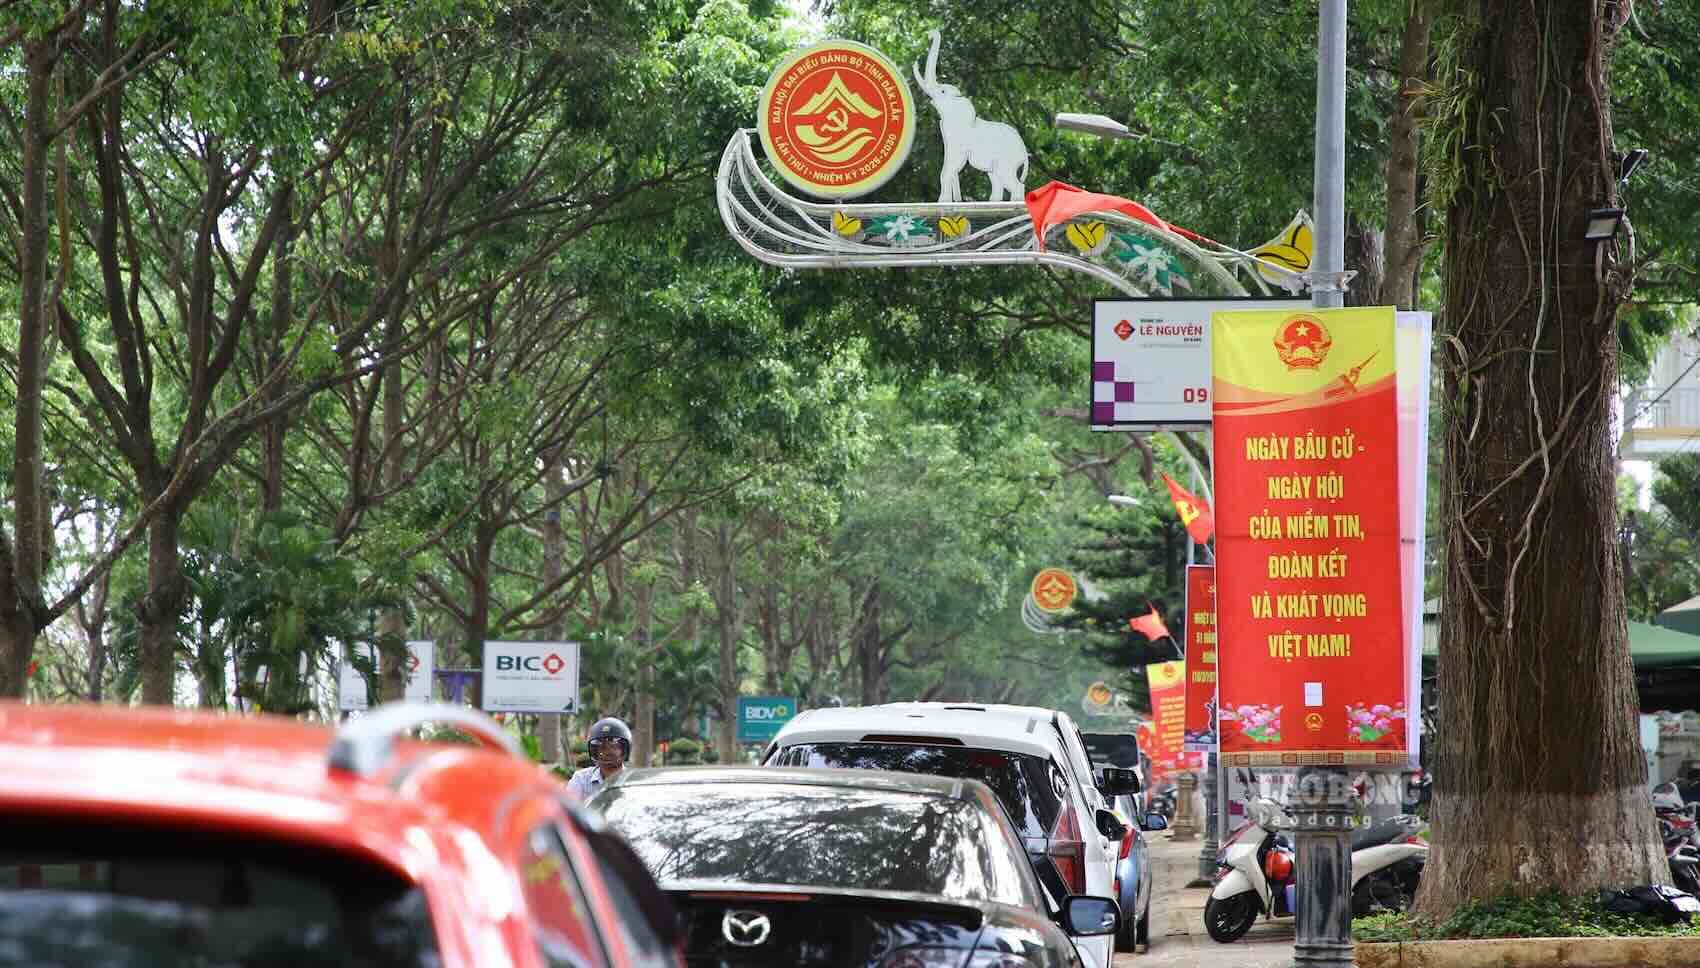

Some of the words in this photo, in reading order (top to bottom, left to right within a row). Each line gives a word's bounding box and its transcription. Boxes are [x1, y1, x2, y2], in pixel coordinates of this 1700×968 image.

[776, 88, 788, 105] HỘI
[784, 74, 798, 88] ĐẠI
[773, 106, 782, 122] ĐẠI
[813, 170, 844, 182] NHIỆM
[861, 134, 896, 176] 2025-2030
[1140, 324, 1153, 336] LÊ
[1246, 433, 1289, 460] NGÀY
[1294, 429, 1326, 460] BẦU
[1332, 428, 1355, 459] CỬ
[1268, 471, 1311, 499] NGÀY
[1317, 471, 1344, 503] HỘI
[1250, 509, 1282, 539] CỦA
[1287, 508, 1329, 538] NIỀM
[1333, 514, 1365, 541] TIN,
[1268, 551, 1313, 578] ĐOÀN
[1318, 547, 1347, 577] KẾT
[1251, 591, 1272, 618] VÀ
[1277, 590, 1318, 618] KHÁT
[1322, 593, 1367, 622] VỌNG
[1268, 629, 1302, 662] VIỆT
[1307, 634, 1351, 656] NAM!
[745, 706, 777, 719] BIDV
